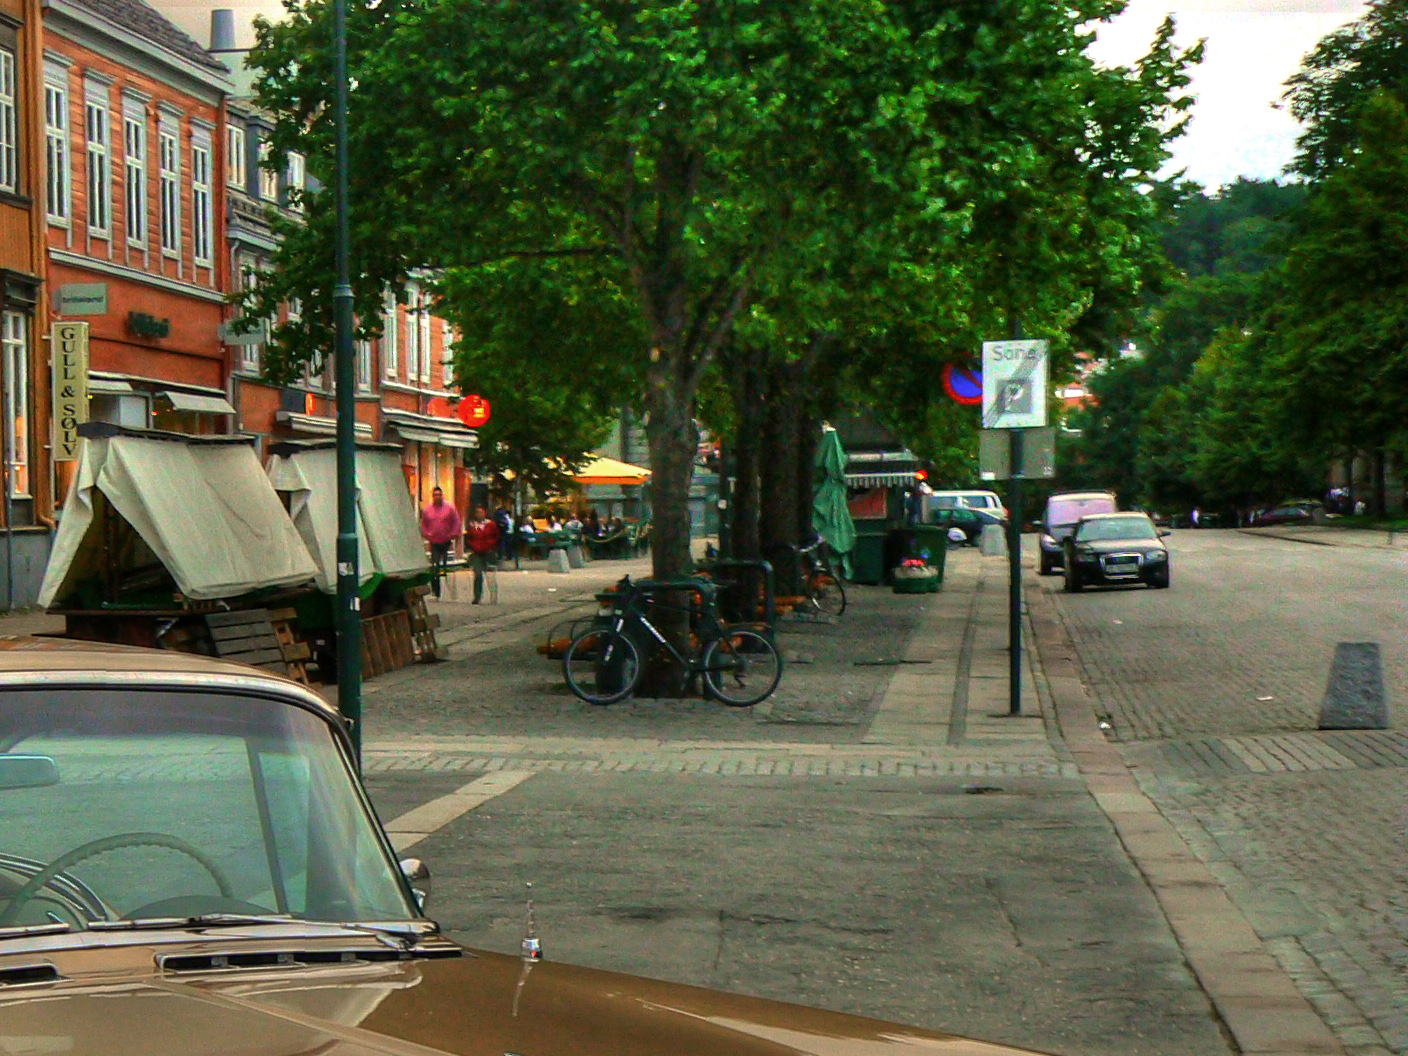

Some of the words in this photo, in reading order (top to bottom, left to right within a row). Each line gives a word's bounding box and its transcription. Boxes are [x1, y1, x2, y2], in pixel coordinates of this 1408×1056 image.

[61, 327, 76, 380] GULL
[992, 345, 1037, 361] Sone
[61, 385, 75, 399] &
[61, 403, 77, 456] SØLV
